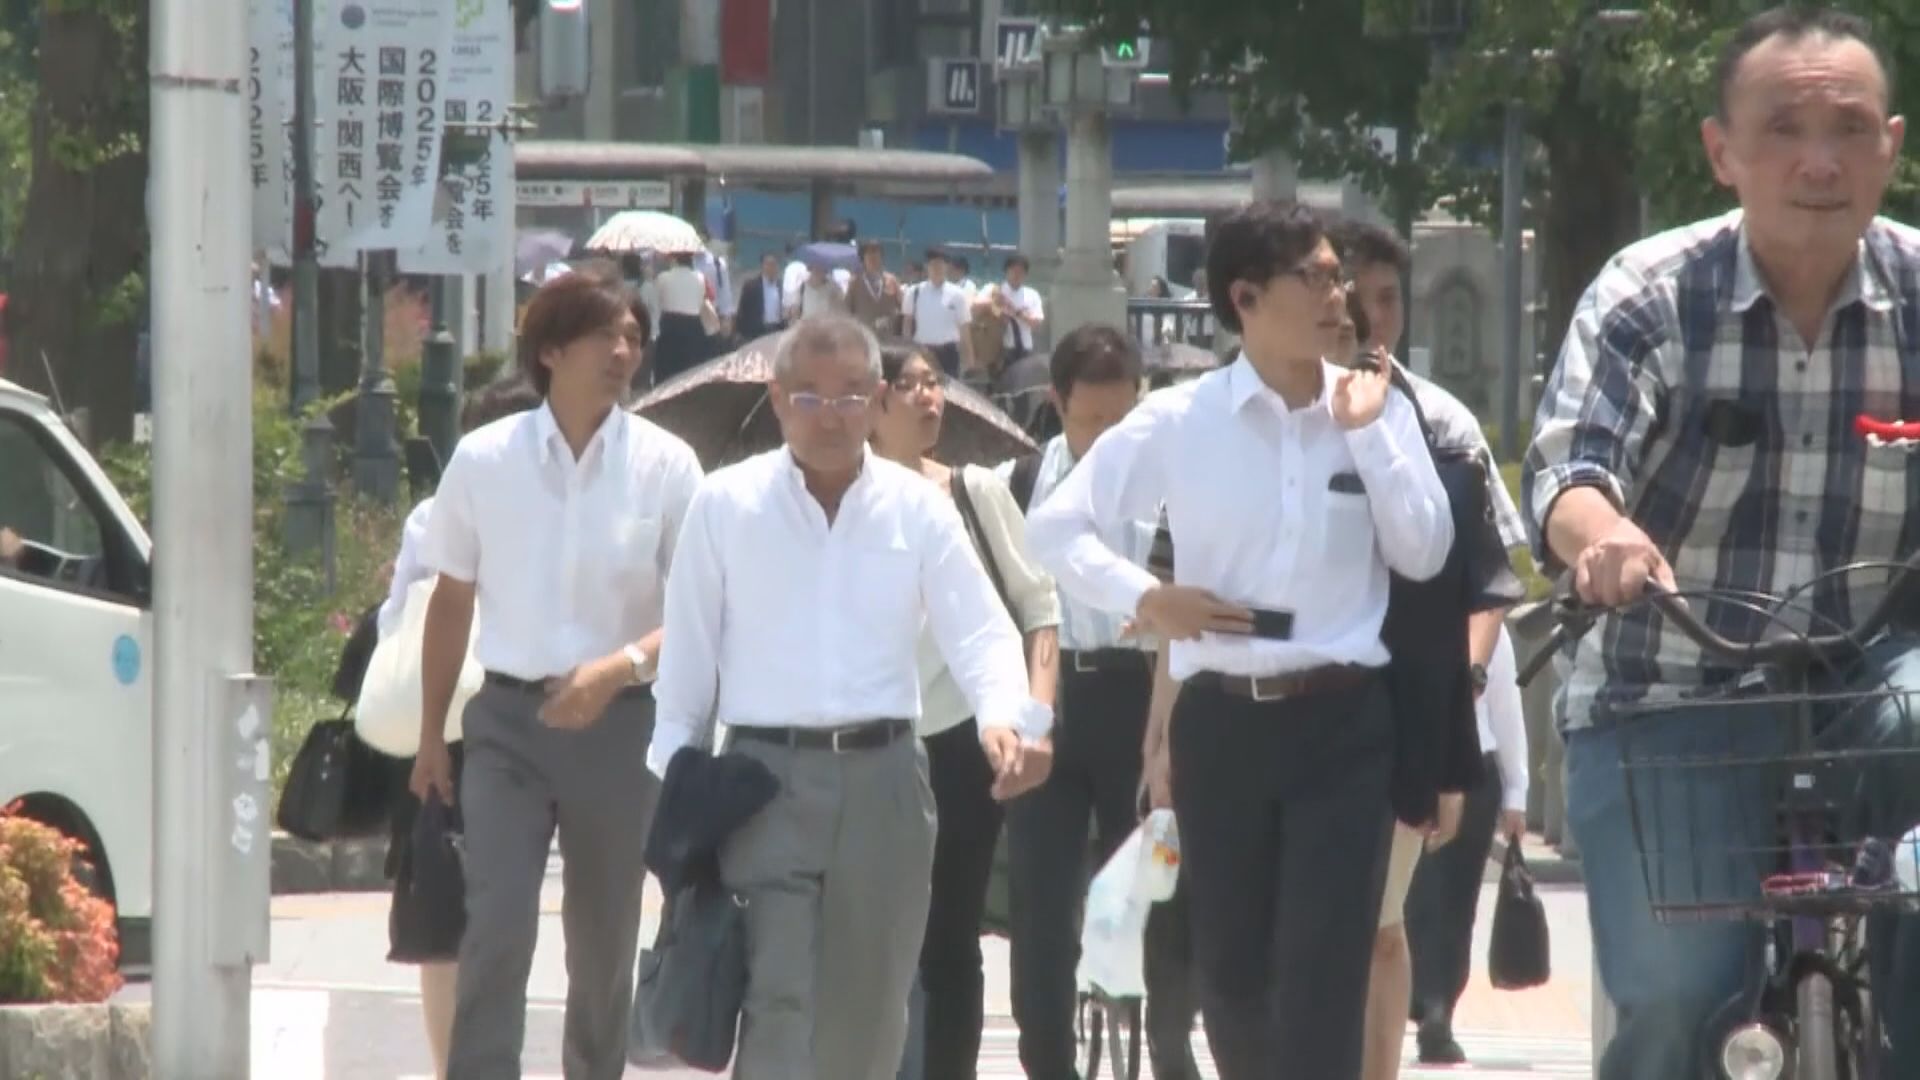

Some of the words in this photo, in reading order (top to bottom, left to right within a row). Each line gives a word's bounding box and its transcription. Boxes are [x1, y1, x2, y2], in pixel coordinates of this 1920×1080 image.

[376, 47, 405, 229] 国際博覧会を
[410, 49, 437, 188] 2025年
